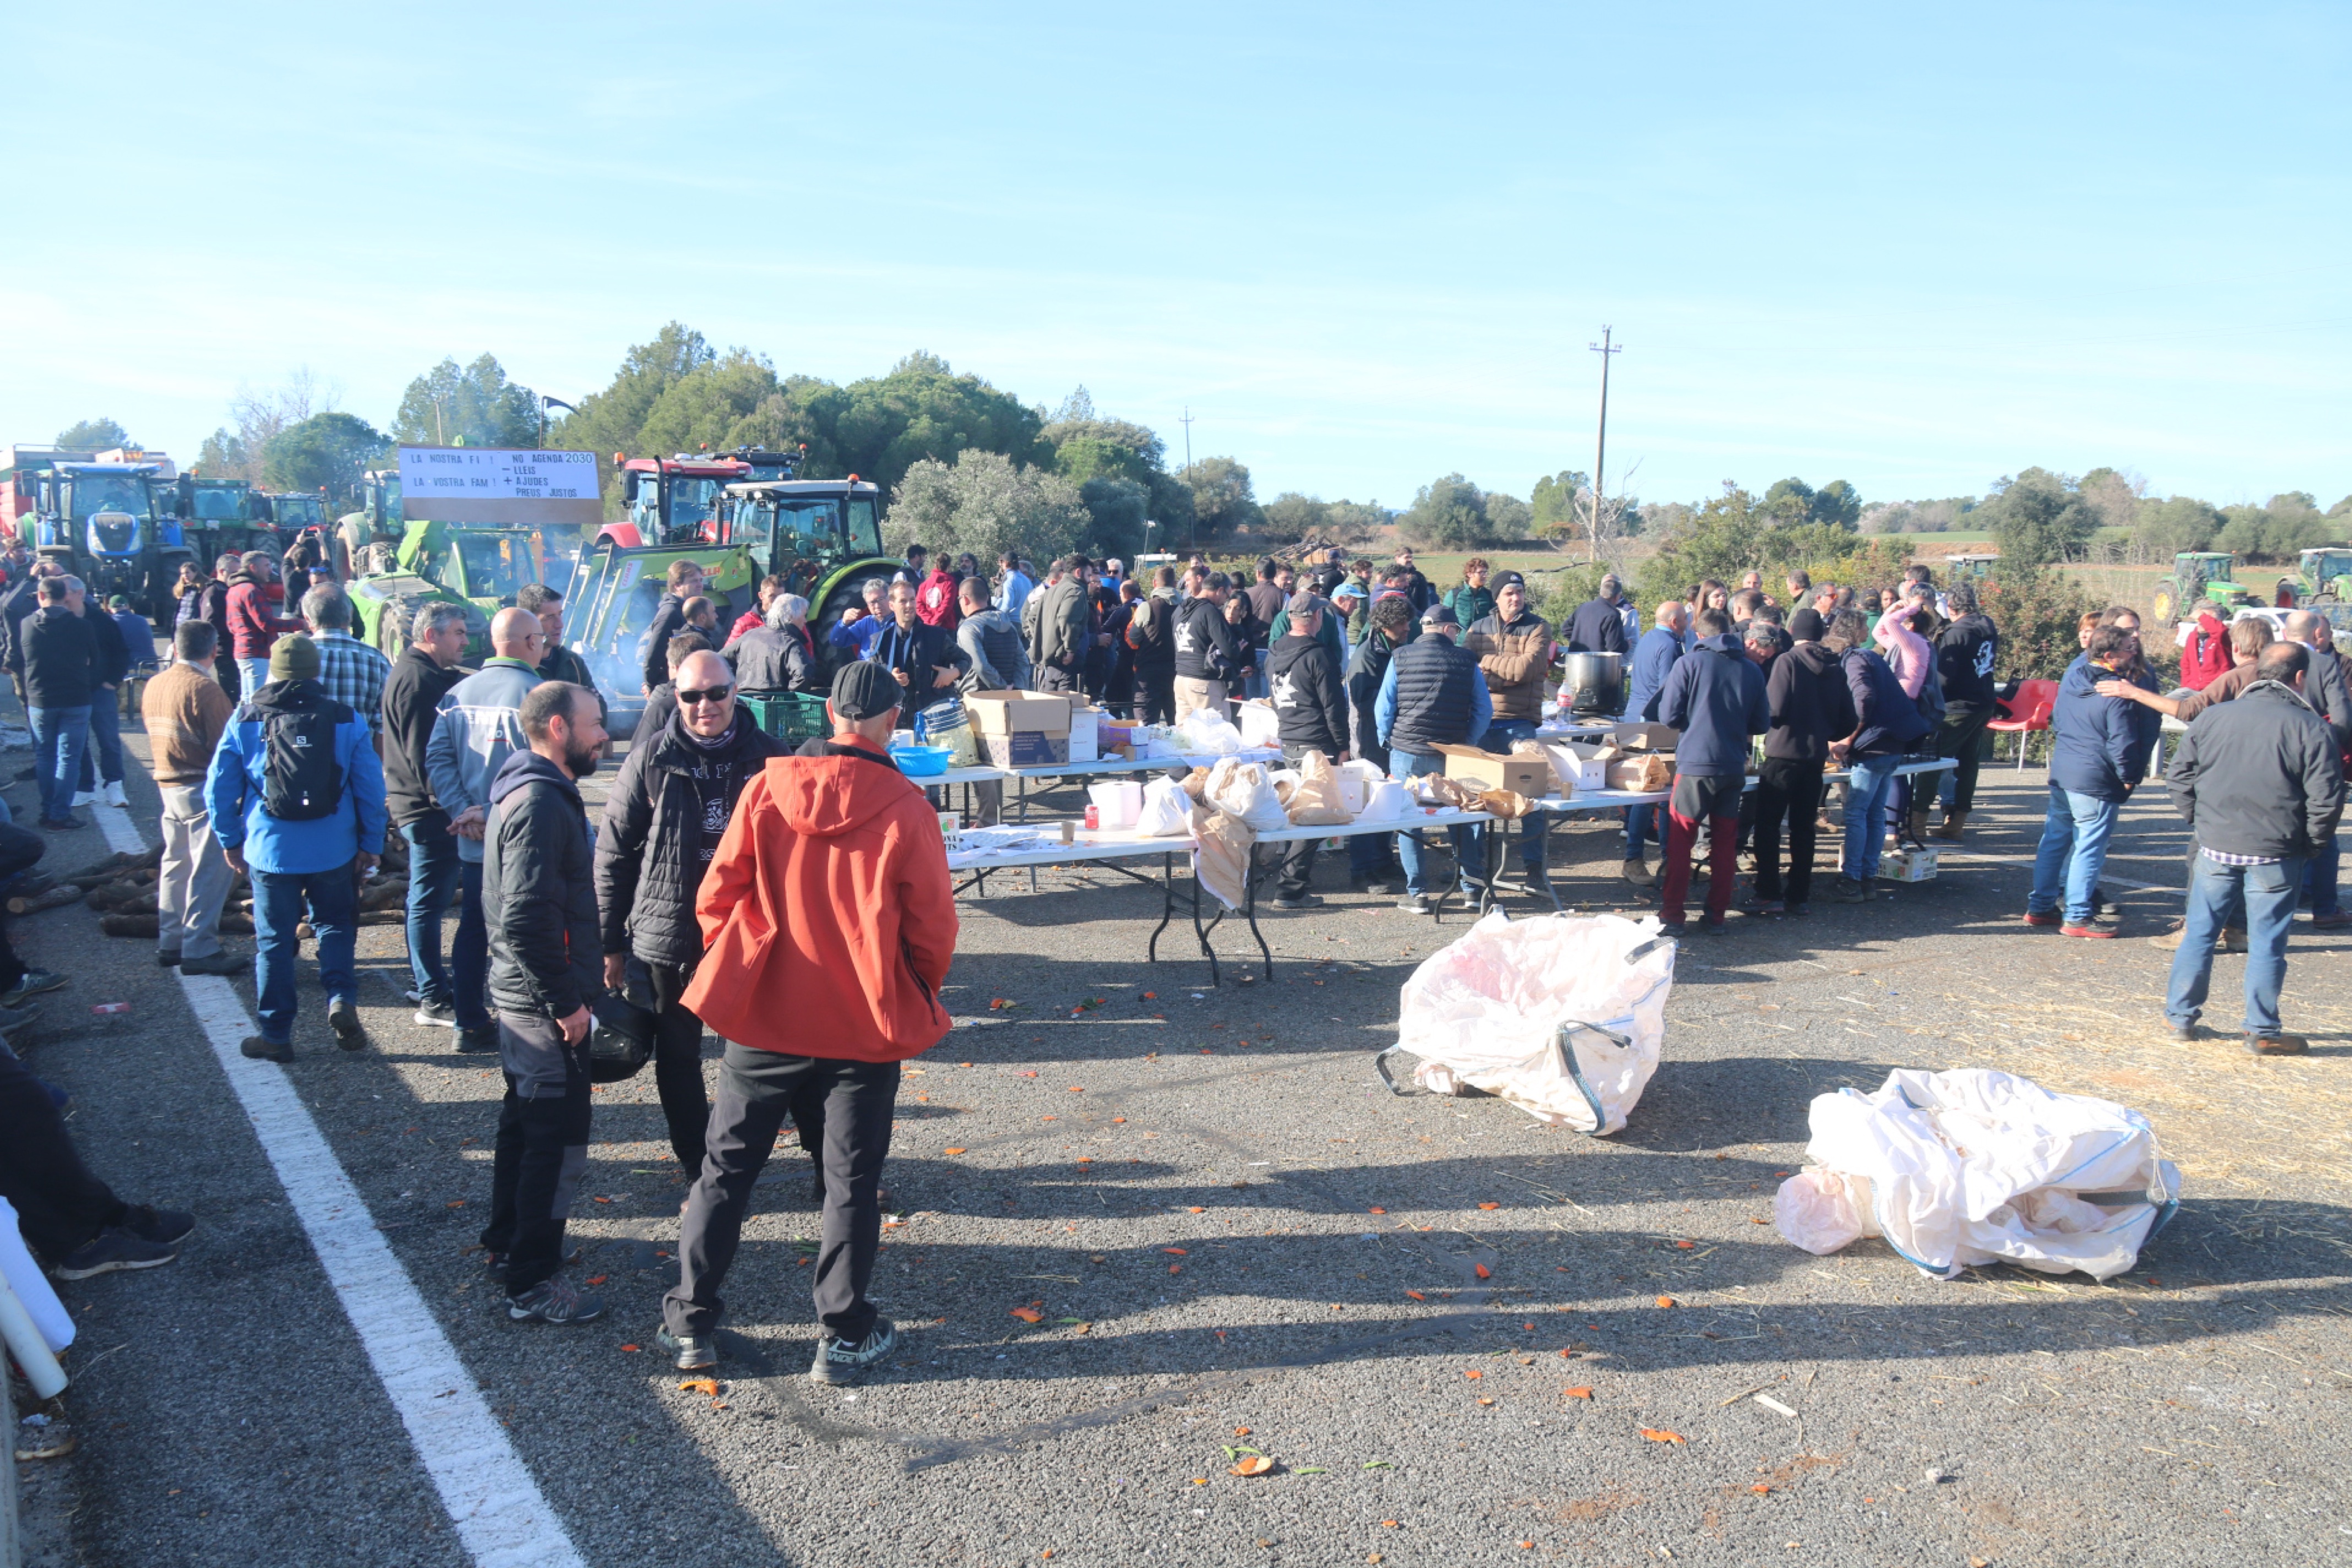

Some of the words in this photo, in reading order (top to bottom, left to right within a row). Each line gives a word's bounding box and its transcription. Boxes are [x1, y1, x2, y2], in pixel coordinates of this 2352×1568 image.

[411, 454, 422, 464] LA
[429, 454, 462, 464] NOSTRA
[512, 454, 524, 463] NO
[532, 454, 563, 464] AGENDA
[565, 453, 592, 464] 2030
[514, 466, 536, 475] LLEIS
[413, 477, 424, 487] LA
[433, 477, 465, 487] VOSTRA
[471, 478, 488, 487] FAM
[516, 476, 548, 486] AJUDES
[516, 487, 541, 498] PREUS
[549, 488, 578, 498] JUSTOS
